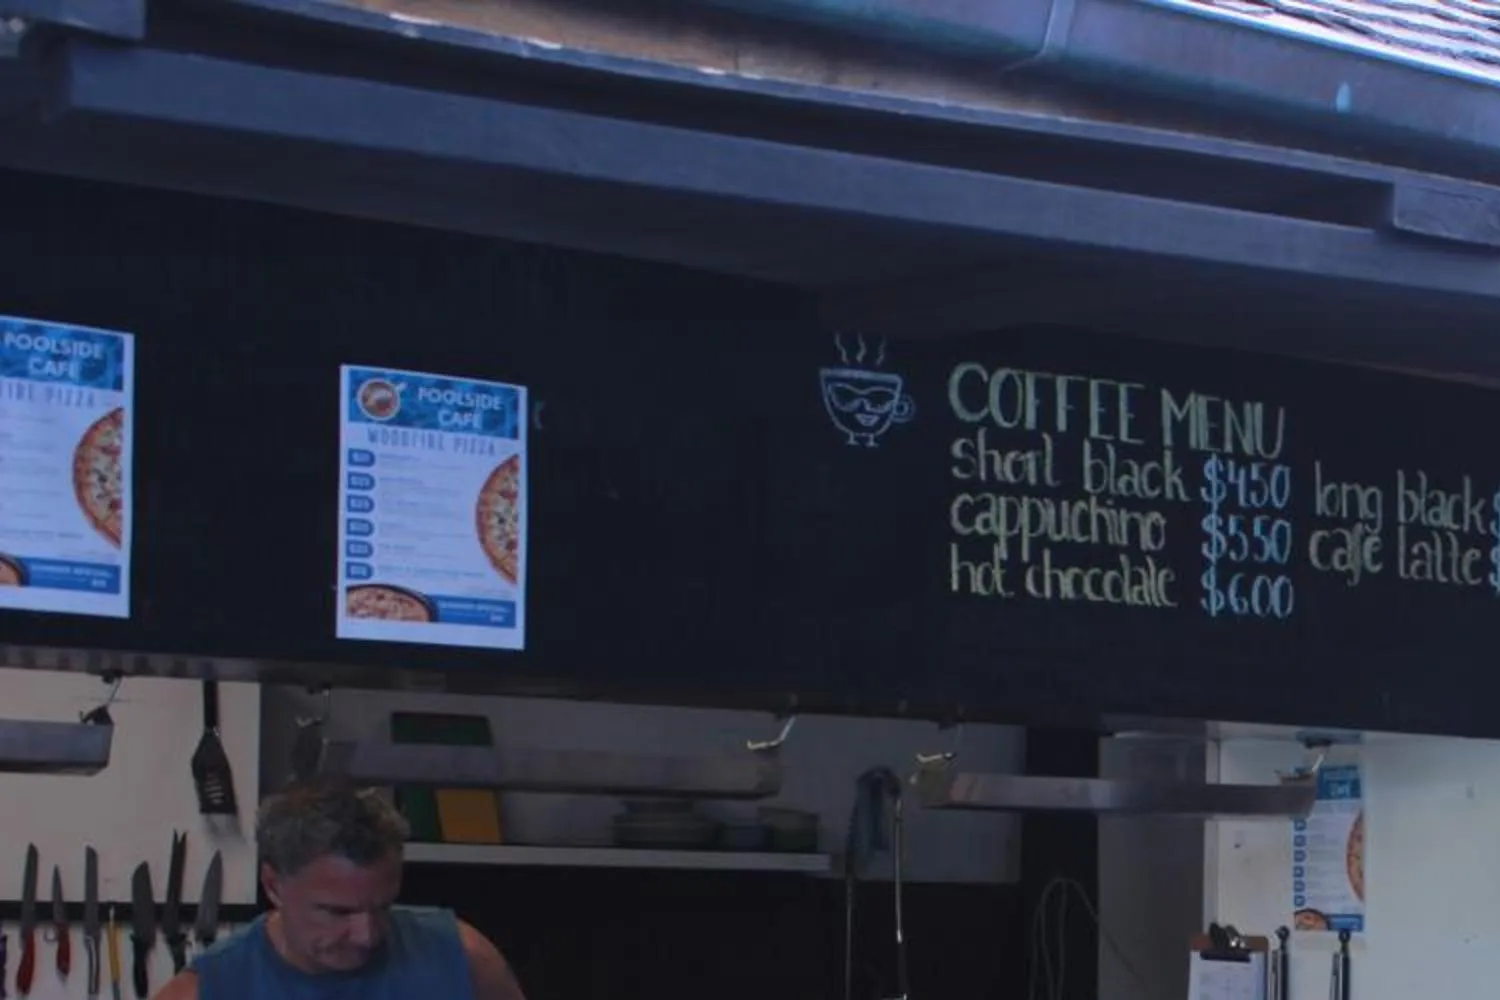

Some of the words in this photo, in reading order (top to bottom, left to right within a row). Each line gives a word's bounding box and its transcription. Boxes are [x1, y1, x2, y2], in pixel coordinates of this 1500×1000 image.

[4, 331, 103, 360] POOLSIDE
[418, 386, 504, 411] POOLSIDE
[948, 361, 1145, 445] COFFEE
[1160, 386, 1284, 460] MENU
[951, 426, 1060, 487] short
[1082, 436, 1191, 502] black
[1313, 460, 1384, 535] long
[1396, 469, 1488, 535] black
[950, 491, 1168, 563] cappuchino
[1398, 526, 1483, 586] latte
[950, 542, 1015, 599] hot
[1024, 547, 1180, 608] chocolate
